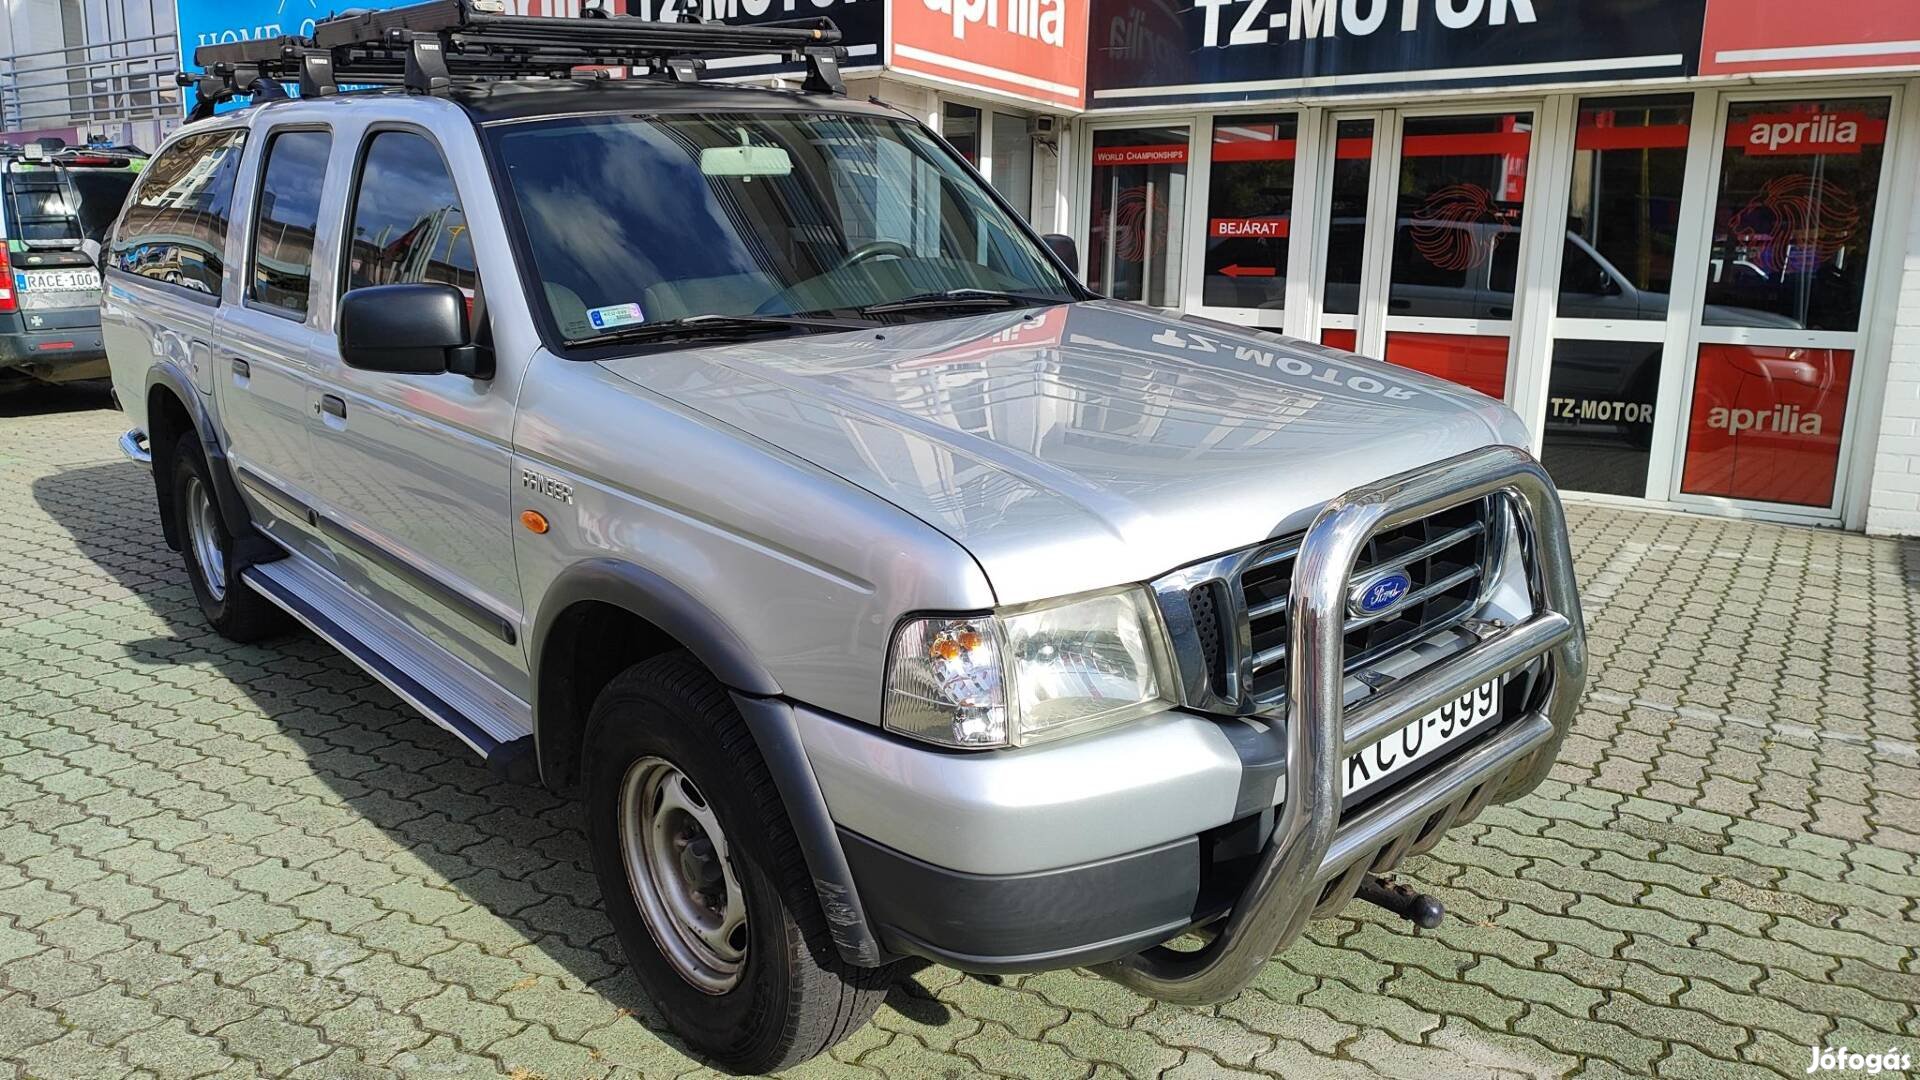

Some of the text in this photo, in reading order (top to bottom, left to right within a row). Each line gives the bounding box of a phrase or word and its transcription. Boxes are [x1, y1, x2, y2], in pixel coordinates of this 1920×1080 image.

[922, 0, 1066, 48] prilia
[1750, 114, 1857, 150] aprilia
[1219, 220, 1278, 235] BEJÁRAT
[1551, 397, 1653, 424] TZ-MOTOR
[1707, 404, 1821, 436] aprilia
[1370, 581, 1402, 606] Ford
